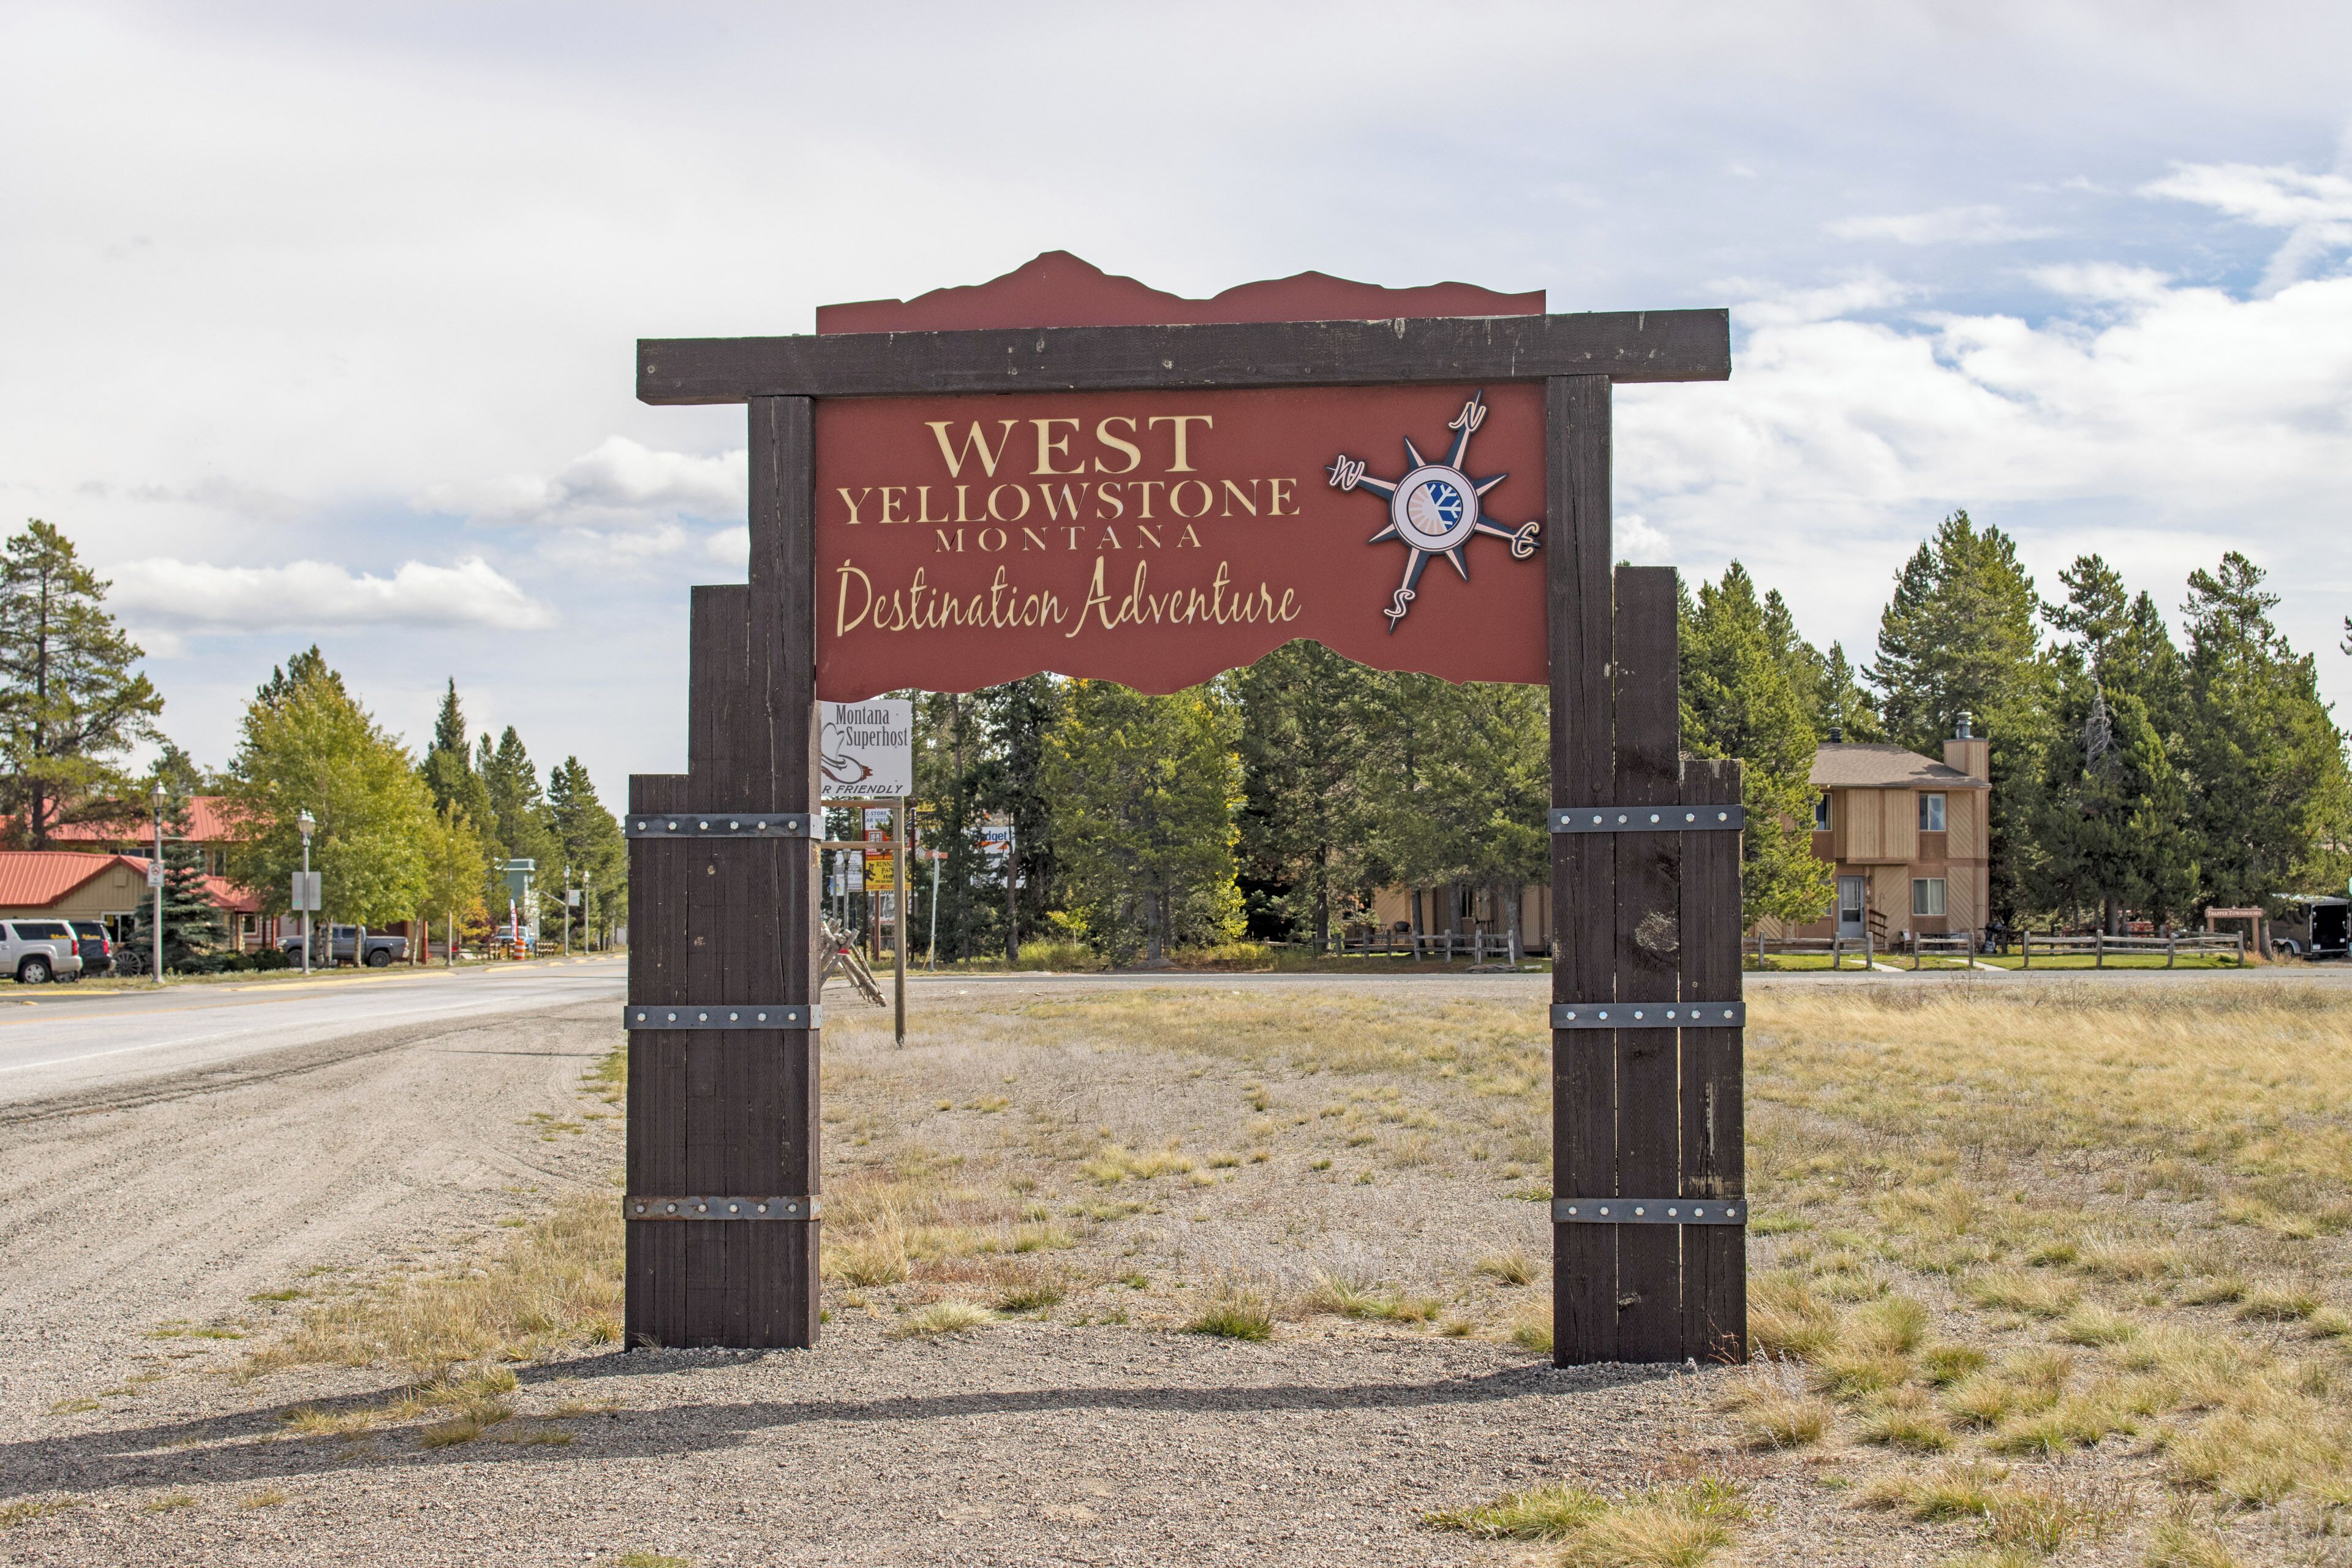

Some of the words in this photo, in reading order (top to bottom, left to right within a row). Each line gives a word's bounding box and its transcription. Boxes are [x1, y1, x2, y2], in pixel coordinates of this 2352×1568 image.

[1448, 401, 1487, 432] N
[924, 415, 1213, 478] WEST
[1329, 454, 1365, 491] W
[836, 478, 1300, 524] YELLOWSTONE
[934, 524, 1202, 552] MONTANA
[1510, 521, 1540, 559] E
[836, 559, 1068, 637] Destination
[1065, 556, 1302, 638] Adventure
[1384, 588, 1416, 618] S
[835, 704, 890, 725] Montana
[846, 726, 908, 750] Superhost
[835, 785, 903, 794] FRIENDLY
